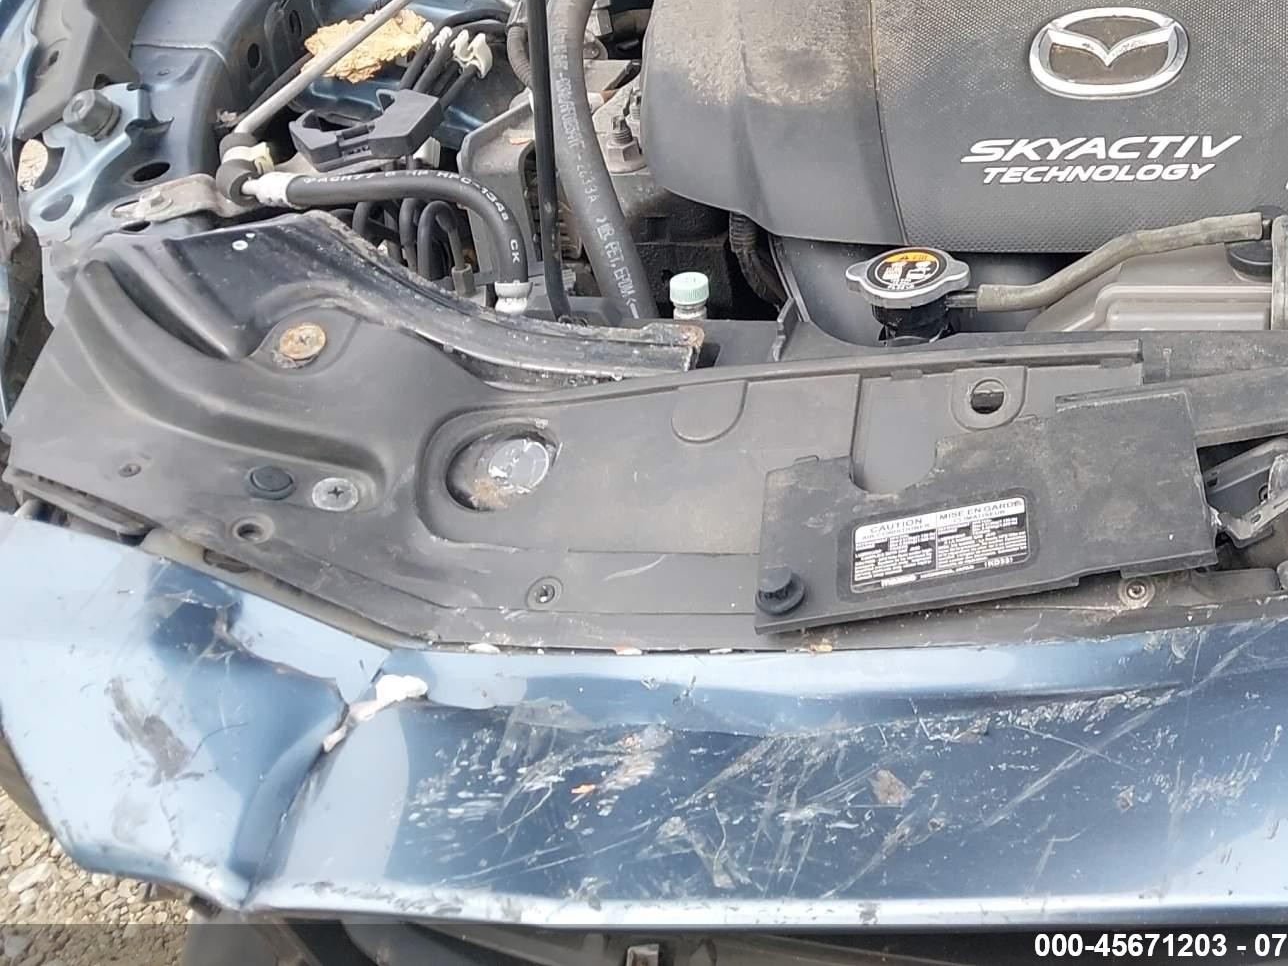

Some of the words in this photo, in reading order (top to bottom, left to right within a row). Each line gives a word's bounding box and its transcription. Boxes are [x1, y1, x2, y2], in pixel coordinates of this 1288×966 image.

[960, 135, 1243, 163] SKYACTIV
[983, 163, 1216, 184] TECHNOLOGY
[510, 239, 521, 264] CK
[939, 510, 966, 521] MISE
[967, 506, 982, 516] EN
[870, 518, 923, 534] CAUTION
